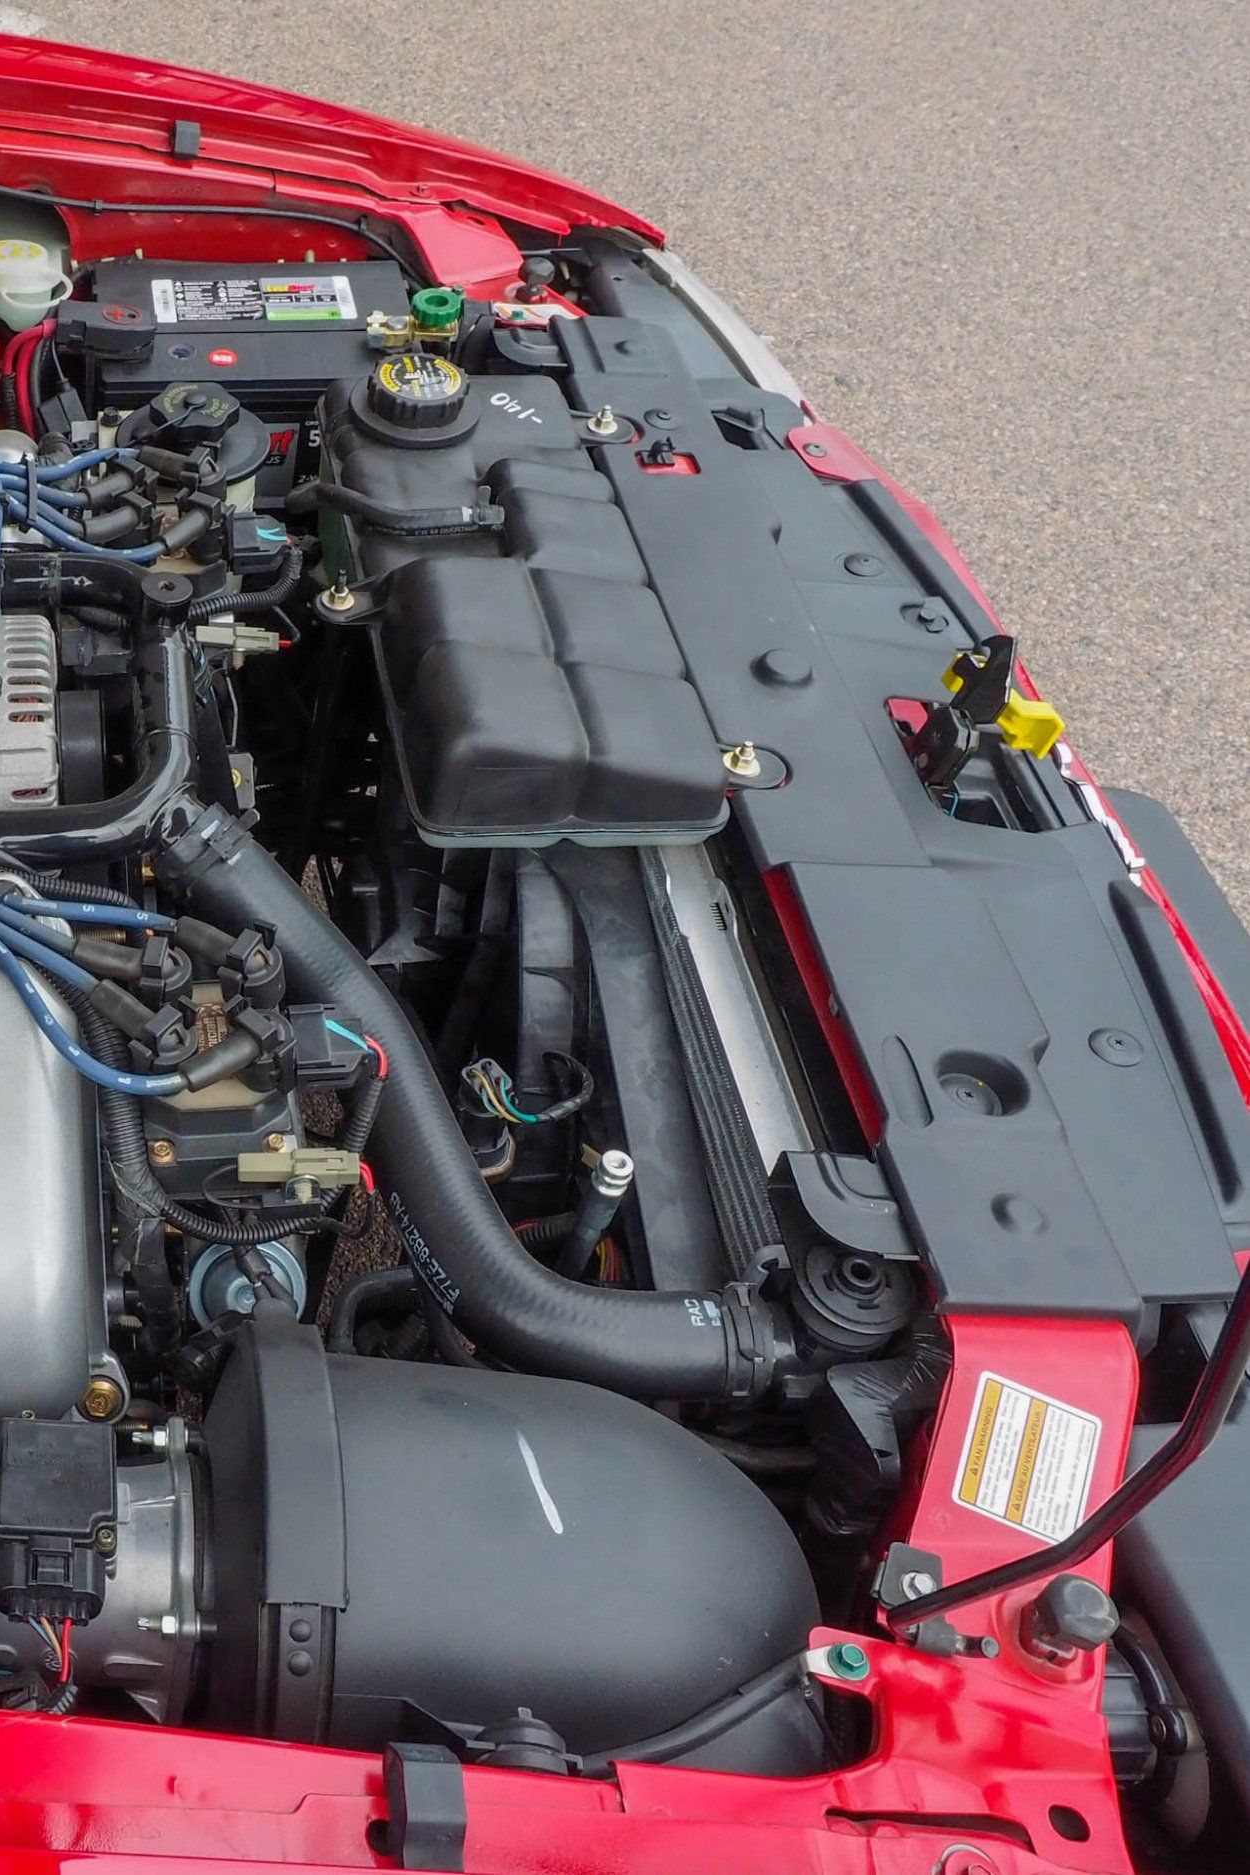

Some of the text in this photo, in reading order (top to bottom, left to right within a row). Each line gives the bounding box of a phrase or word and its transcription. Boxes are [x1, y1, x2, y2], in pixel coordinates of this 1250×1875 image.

[490, 392, 543, 424] -140
[390, 1191, 461, 1303] F7ZE-8B274-AB
[974, 1405, 994, 1467] FAN WARNING
[1016, 1409, 1042, 1502] GARE AU VENTILATEUR
